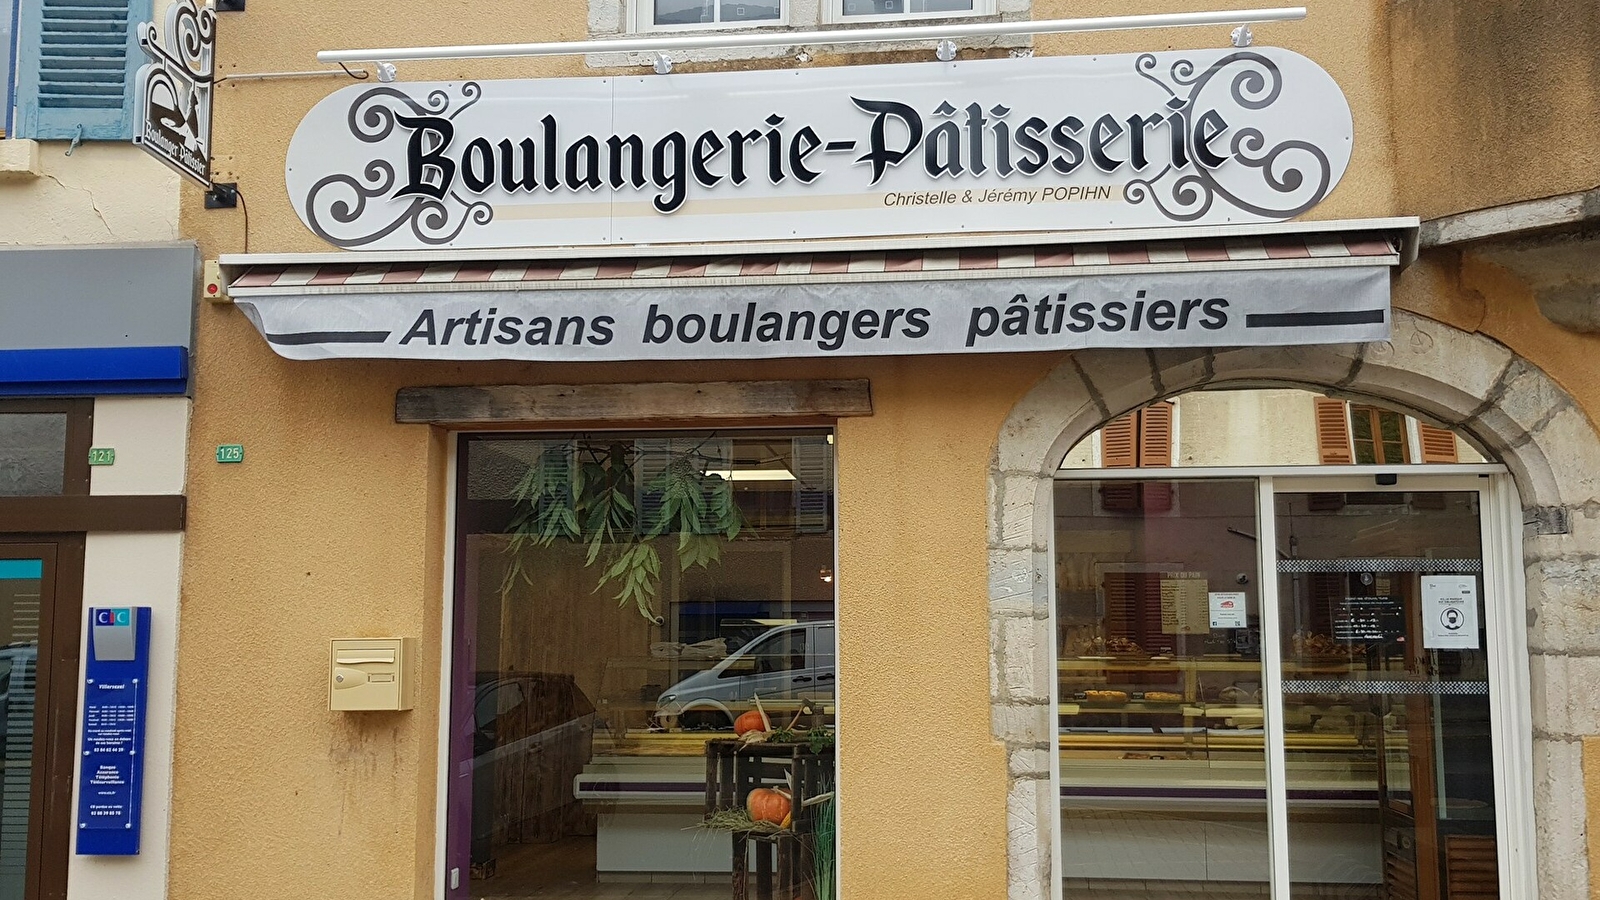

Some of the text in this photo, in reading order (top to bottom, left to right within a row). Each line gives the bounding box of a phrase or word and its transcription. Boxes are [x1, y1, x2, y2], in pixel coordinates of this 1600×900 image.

[145, 119, 206, 176] Boulanger Pâtissier
[389, 97, 1229, 213] Boulangerie-Pâtisserie
[884, 186, 1112, 207] Christelle & Jérémy POPIHN
[398, 290, 1231, 352] Artisans boulangers pâtissiers
[91, 450, 111, 462] 121
[219, 447, 240, 459] 125
[97, 611, 128, 624] CIC
